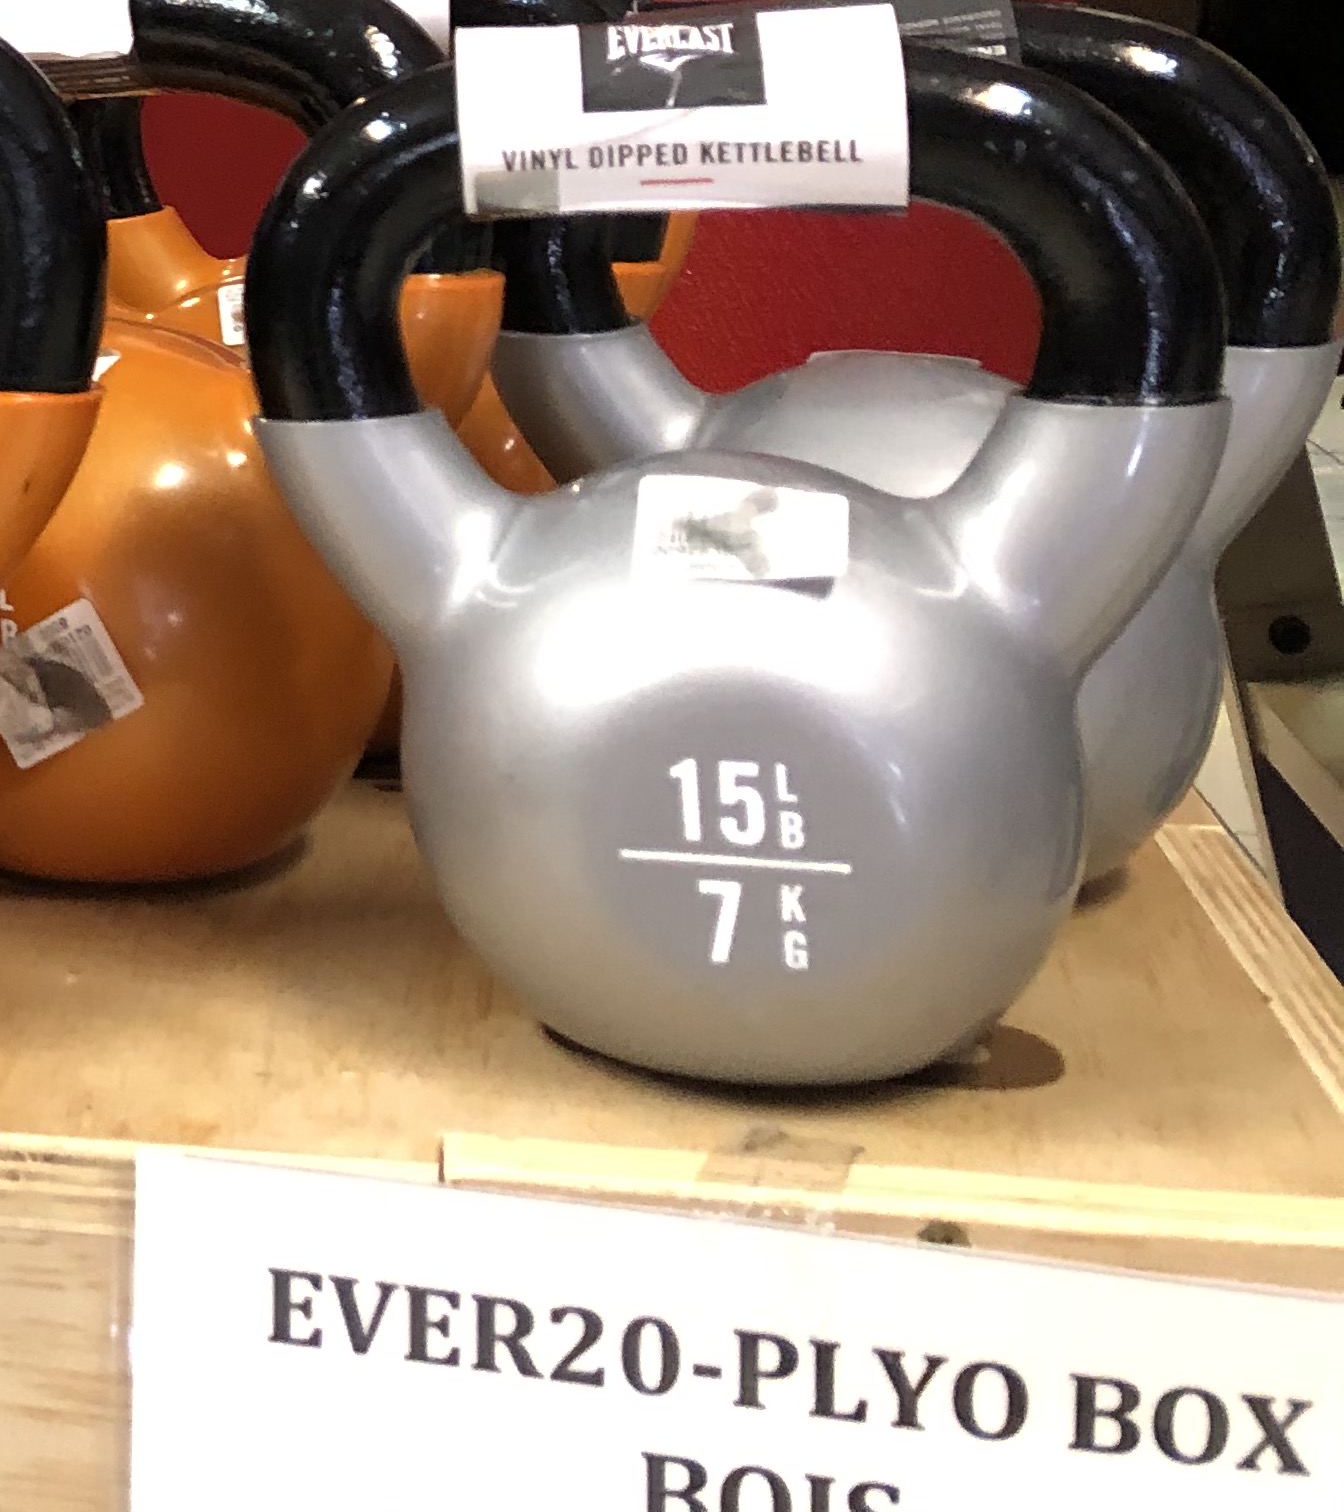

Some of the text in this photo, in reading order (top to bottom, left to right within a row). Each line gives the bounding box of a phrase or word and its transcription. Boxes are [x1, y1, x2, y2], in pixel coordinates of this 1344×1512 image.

[606, 23, 734, 61] EVERLAST
[502, 139, 864, 173] VINYL DIPPED KETTLEBELL
[669, 757, 766, 847] 15
[696, 879, 742, 965] 7
[265, 1265, 1316, 1478] EVER20-PLYO BOX
